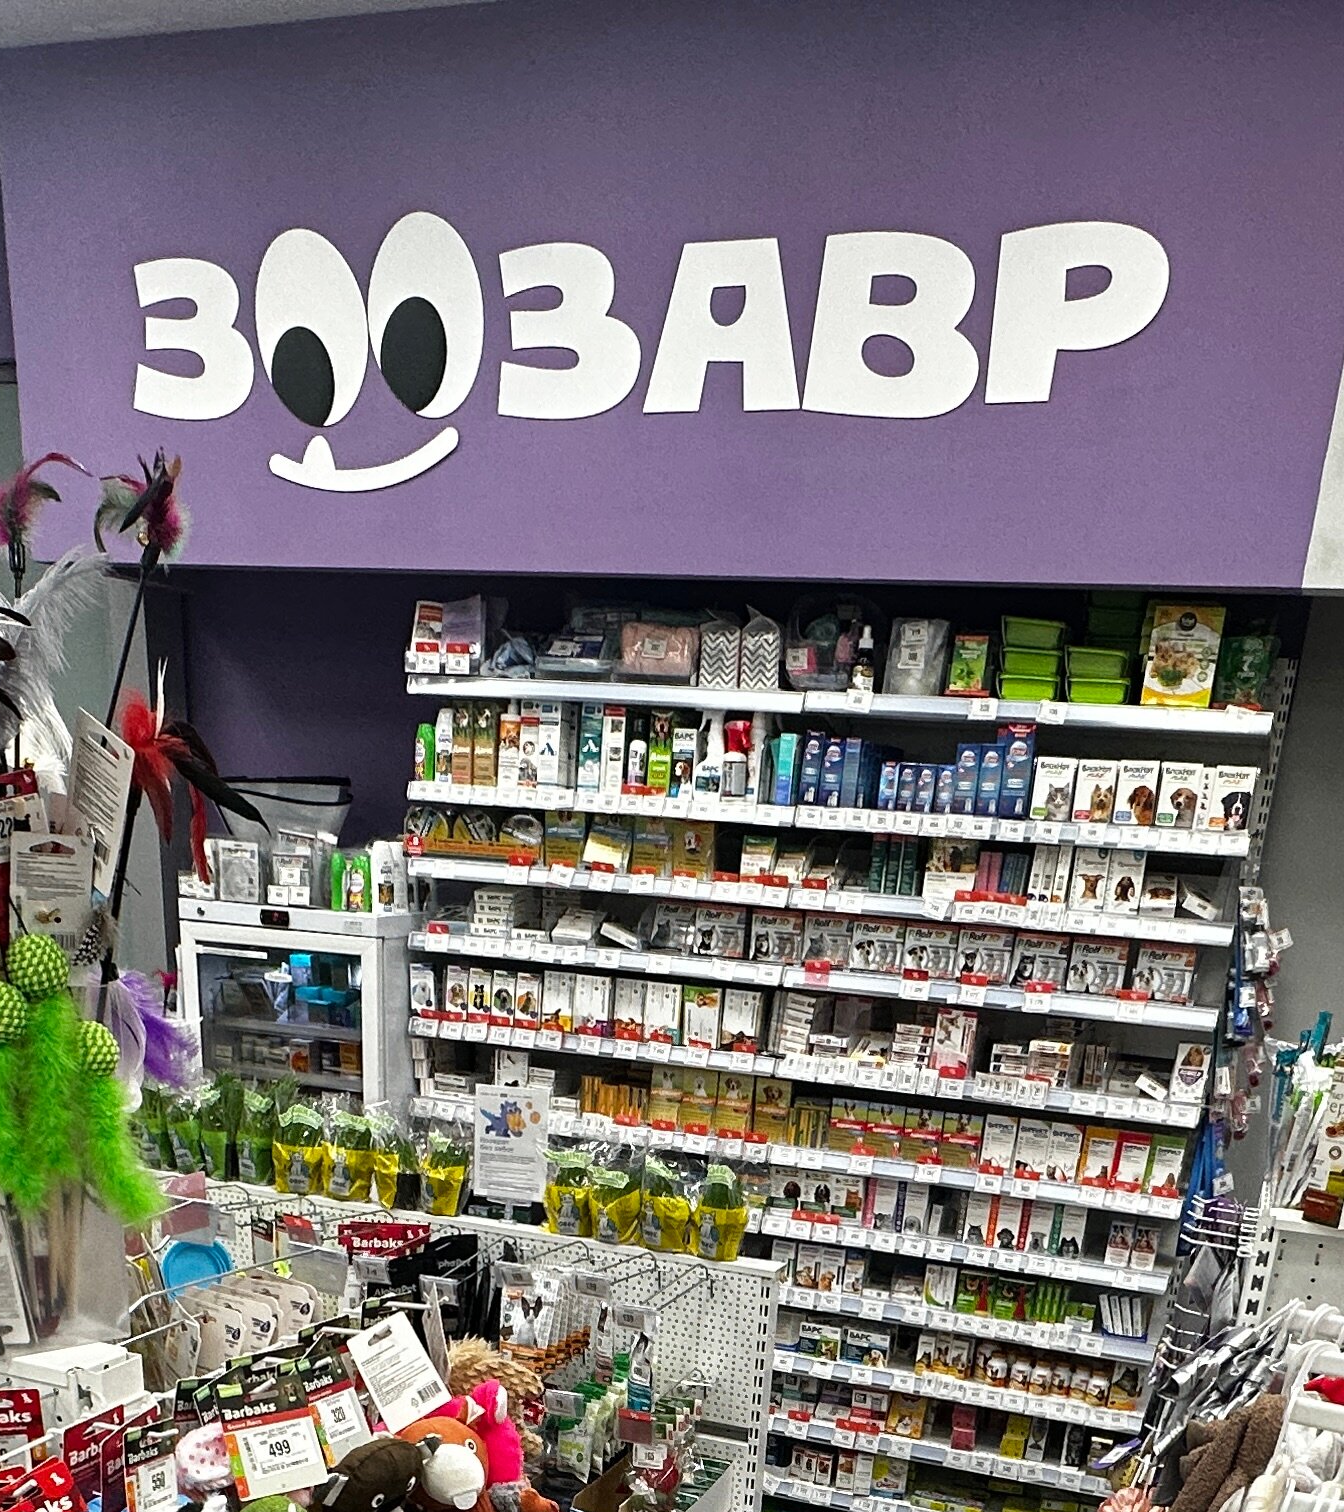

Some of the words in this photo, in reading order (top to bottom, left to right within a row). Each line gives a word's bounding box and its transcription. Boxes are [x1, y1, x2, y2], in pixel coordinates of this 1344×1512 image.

[133, 211, 1170, 428] ЗООЗАВР
[351, 1236, 404, 1250] Barbaks
[222, 1401, 277, 1421] Barbaks
[268, 1438, 292, 1458] 499
